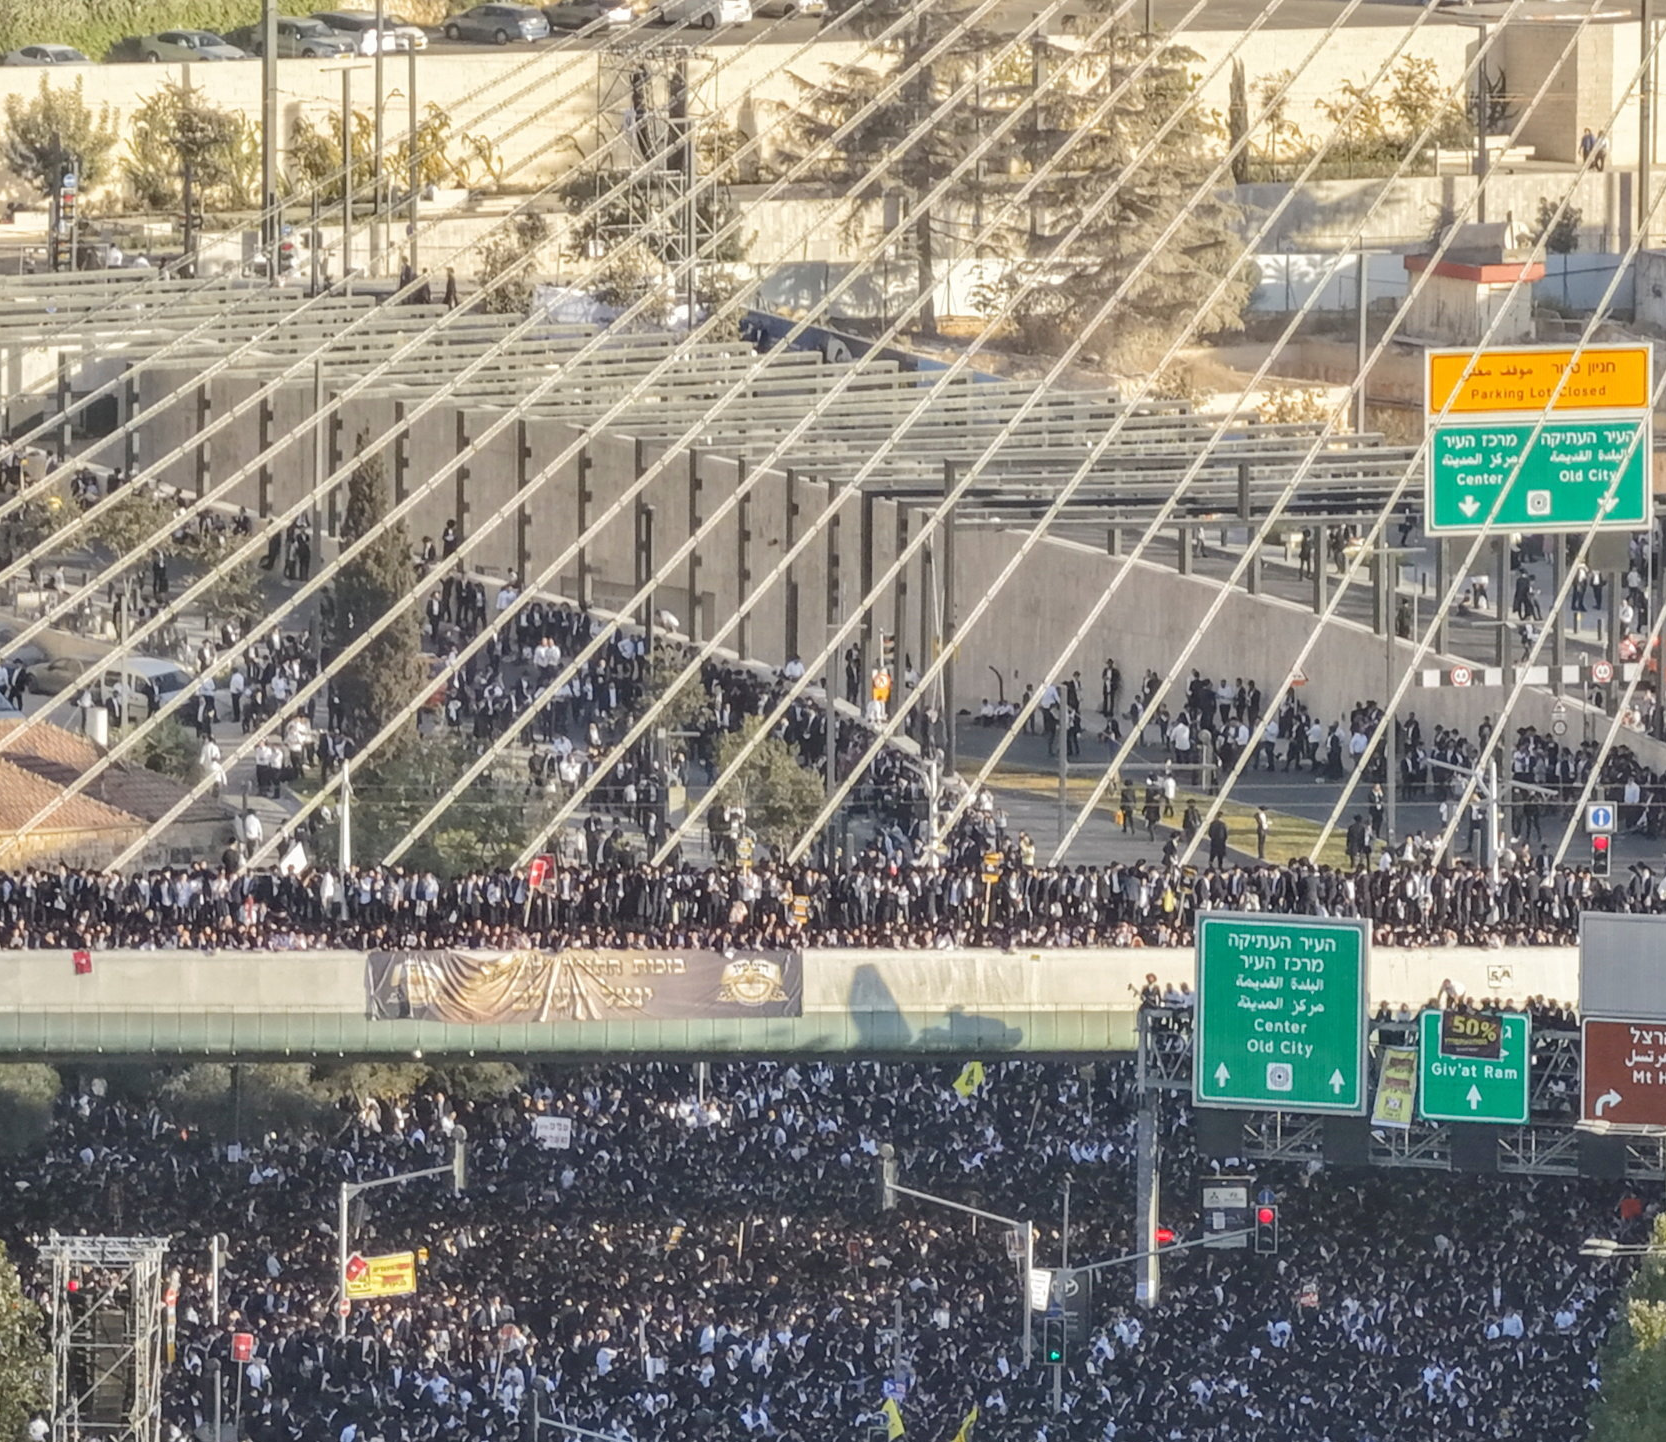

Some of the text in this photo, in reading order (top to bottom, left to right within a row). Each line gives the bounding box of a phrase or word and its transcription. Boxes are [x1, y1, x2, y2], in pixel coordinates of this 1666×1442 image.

[1551, 361, 1616, 377] חניון סור
[1471, 389, 1524, 401] Parking
[1530, 387, 1549, 399] Lot
[1442, 433, 1517, 450] מרכז העיר
[1540, 430, 1636, 448] העיר העתיקה
[1441, 453, 1482, 468] المدينة
[1456, 472, 1504, 486] Center
[1559, 468, 1617, 484] Old City
[1228, 933, 1336, 953] העיר העתיקה
[632, 957, 687, 976] בזכות
[1240, 954, 1324, 973] מרכז העיר
[1235, 974, 1324, 995] البلدة القديمة
[1236, 994, 1325, 1017] مركز المدينة
[1254, 1018, 1308, 1035] Center
[1452, 1016, 1498, 1043] 50%
[1246, 1039, 1314, 1059] Old City
[1431, 1062, 1519, 1080] Giv'at Ram
[1632, 1070, 1652, 1084] Mt
